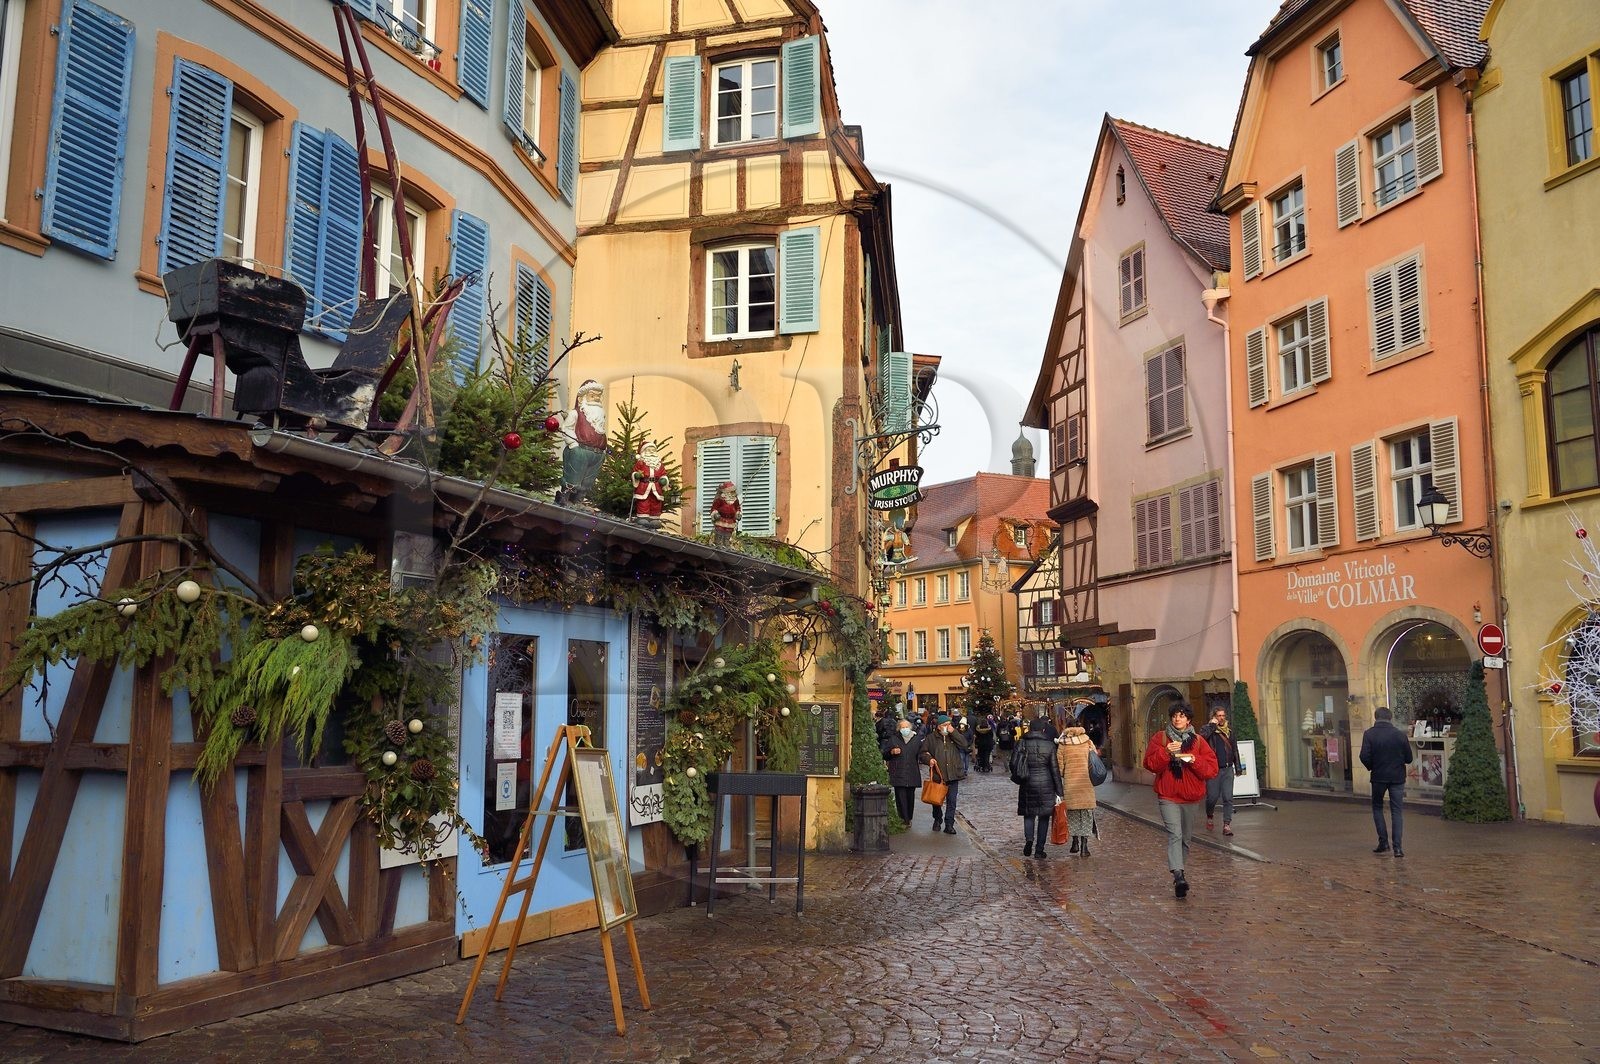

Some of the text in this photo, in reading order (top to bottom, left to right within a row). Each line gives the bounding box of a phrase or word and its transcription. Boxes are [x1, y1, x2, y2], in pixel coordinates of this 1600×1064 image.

[874, 492, 918, 509] IRISH STOUT
[1287, 555, 1396, 589] Domaine Viticole
[1297, 589, 1318, 603] Ville
[1326, 574, 1417, 609] COLMAR
